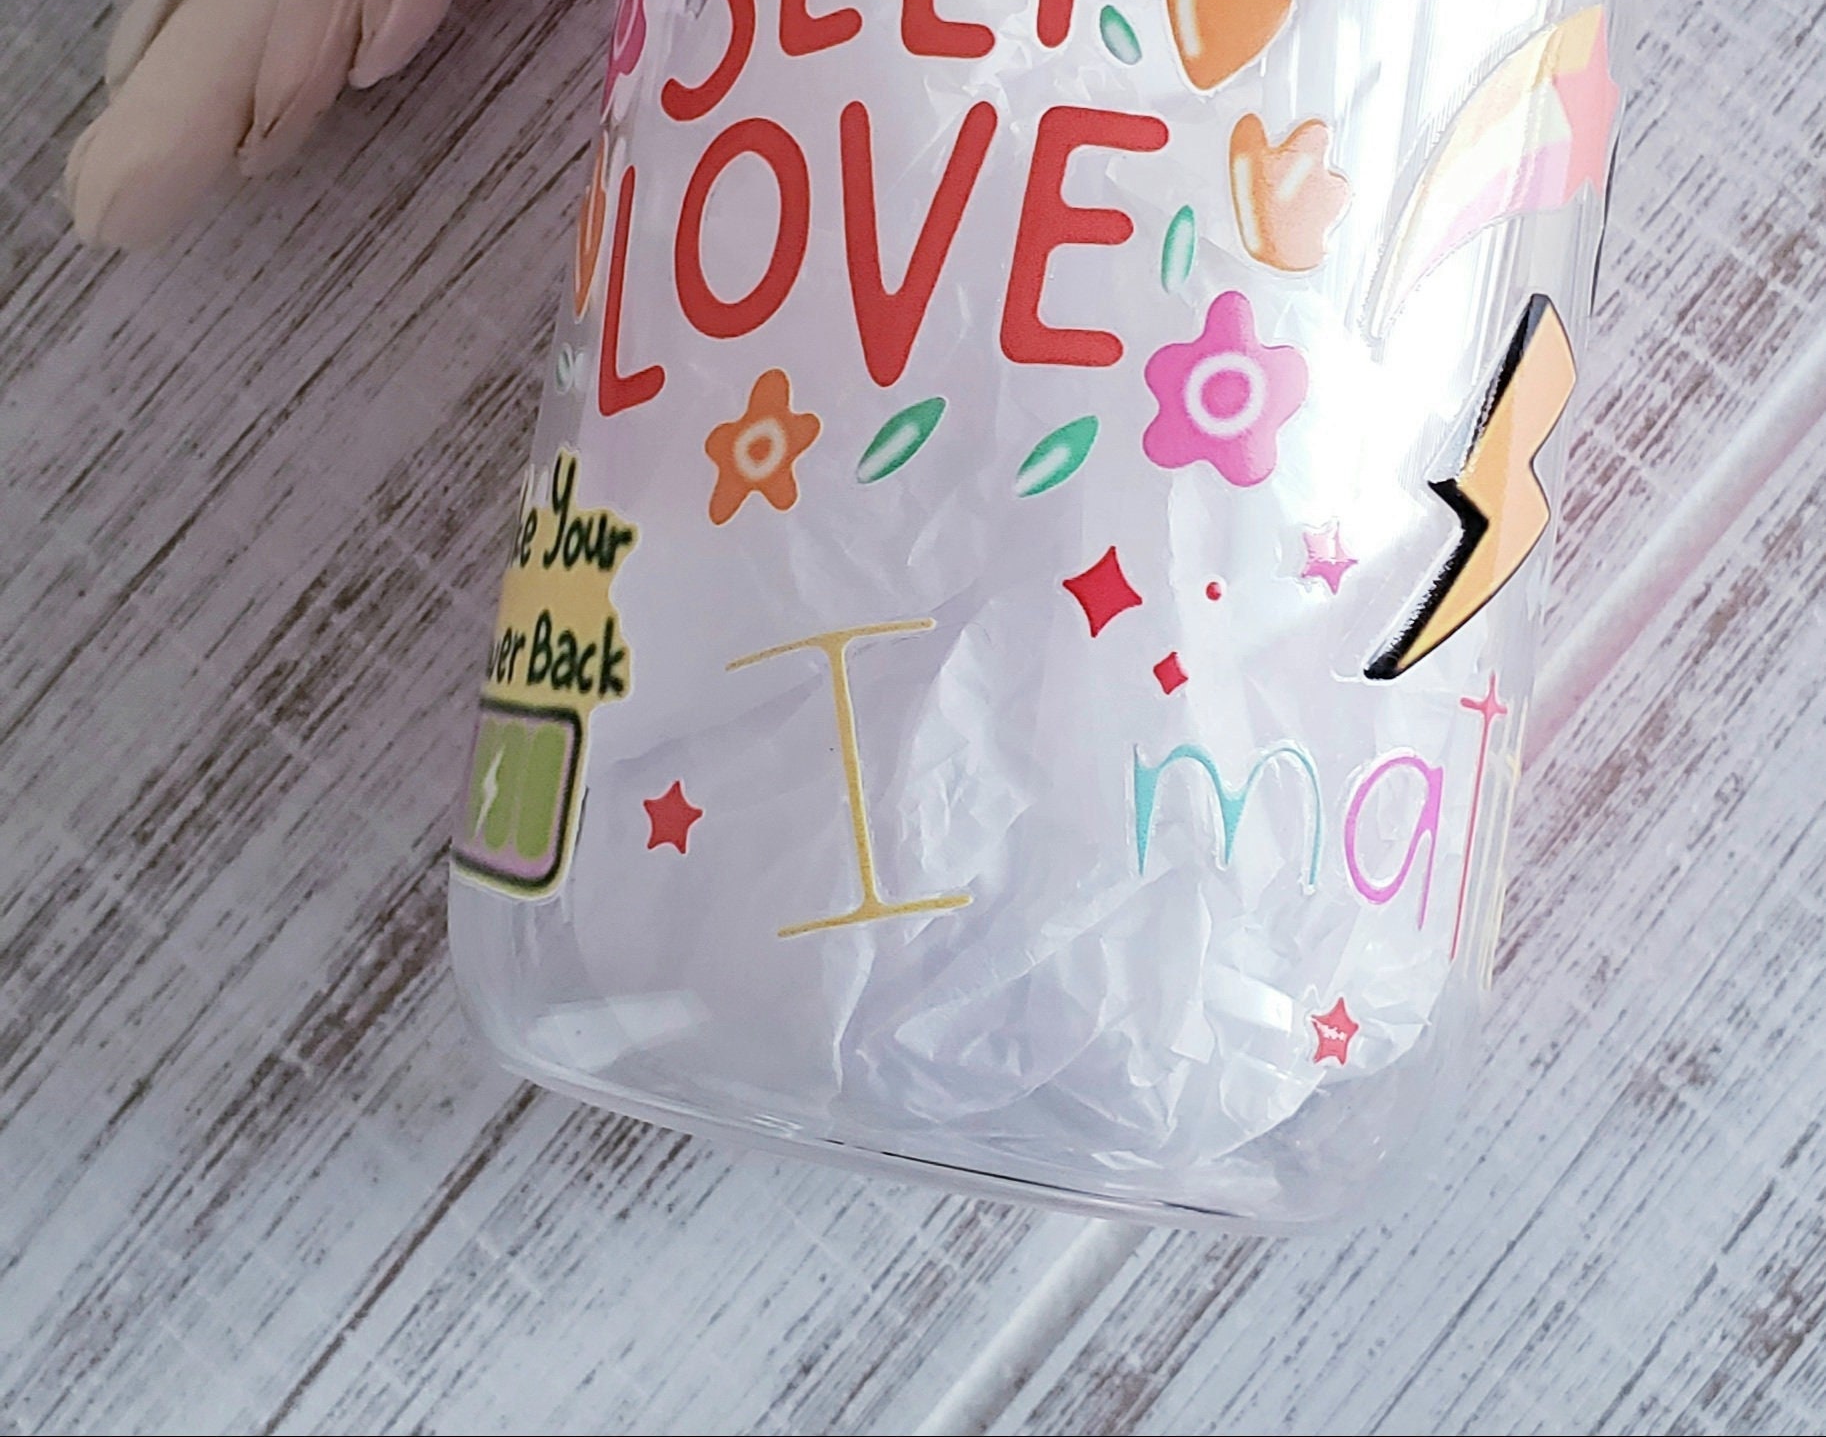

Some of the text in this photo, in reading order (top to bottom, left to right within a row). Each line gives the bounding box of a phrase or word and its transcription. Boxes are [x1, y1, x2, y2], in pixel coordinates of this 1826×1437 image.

[599, 100, 1170, 417] LOVE
[526, 608, 626, 698] Back
[725, 616, 976, 940] I
